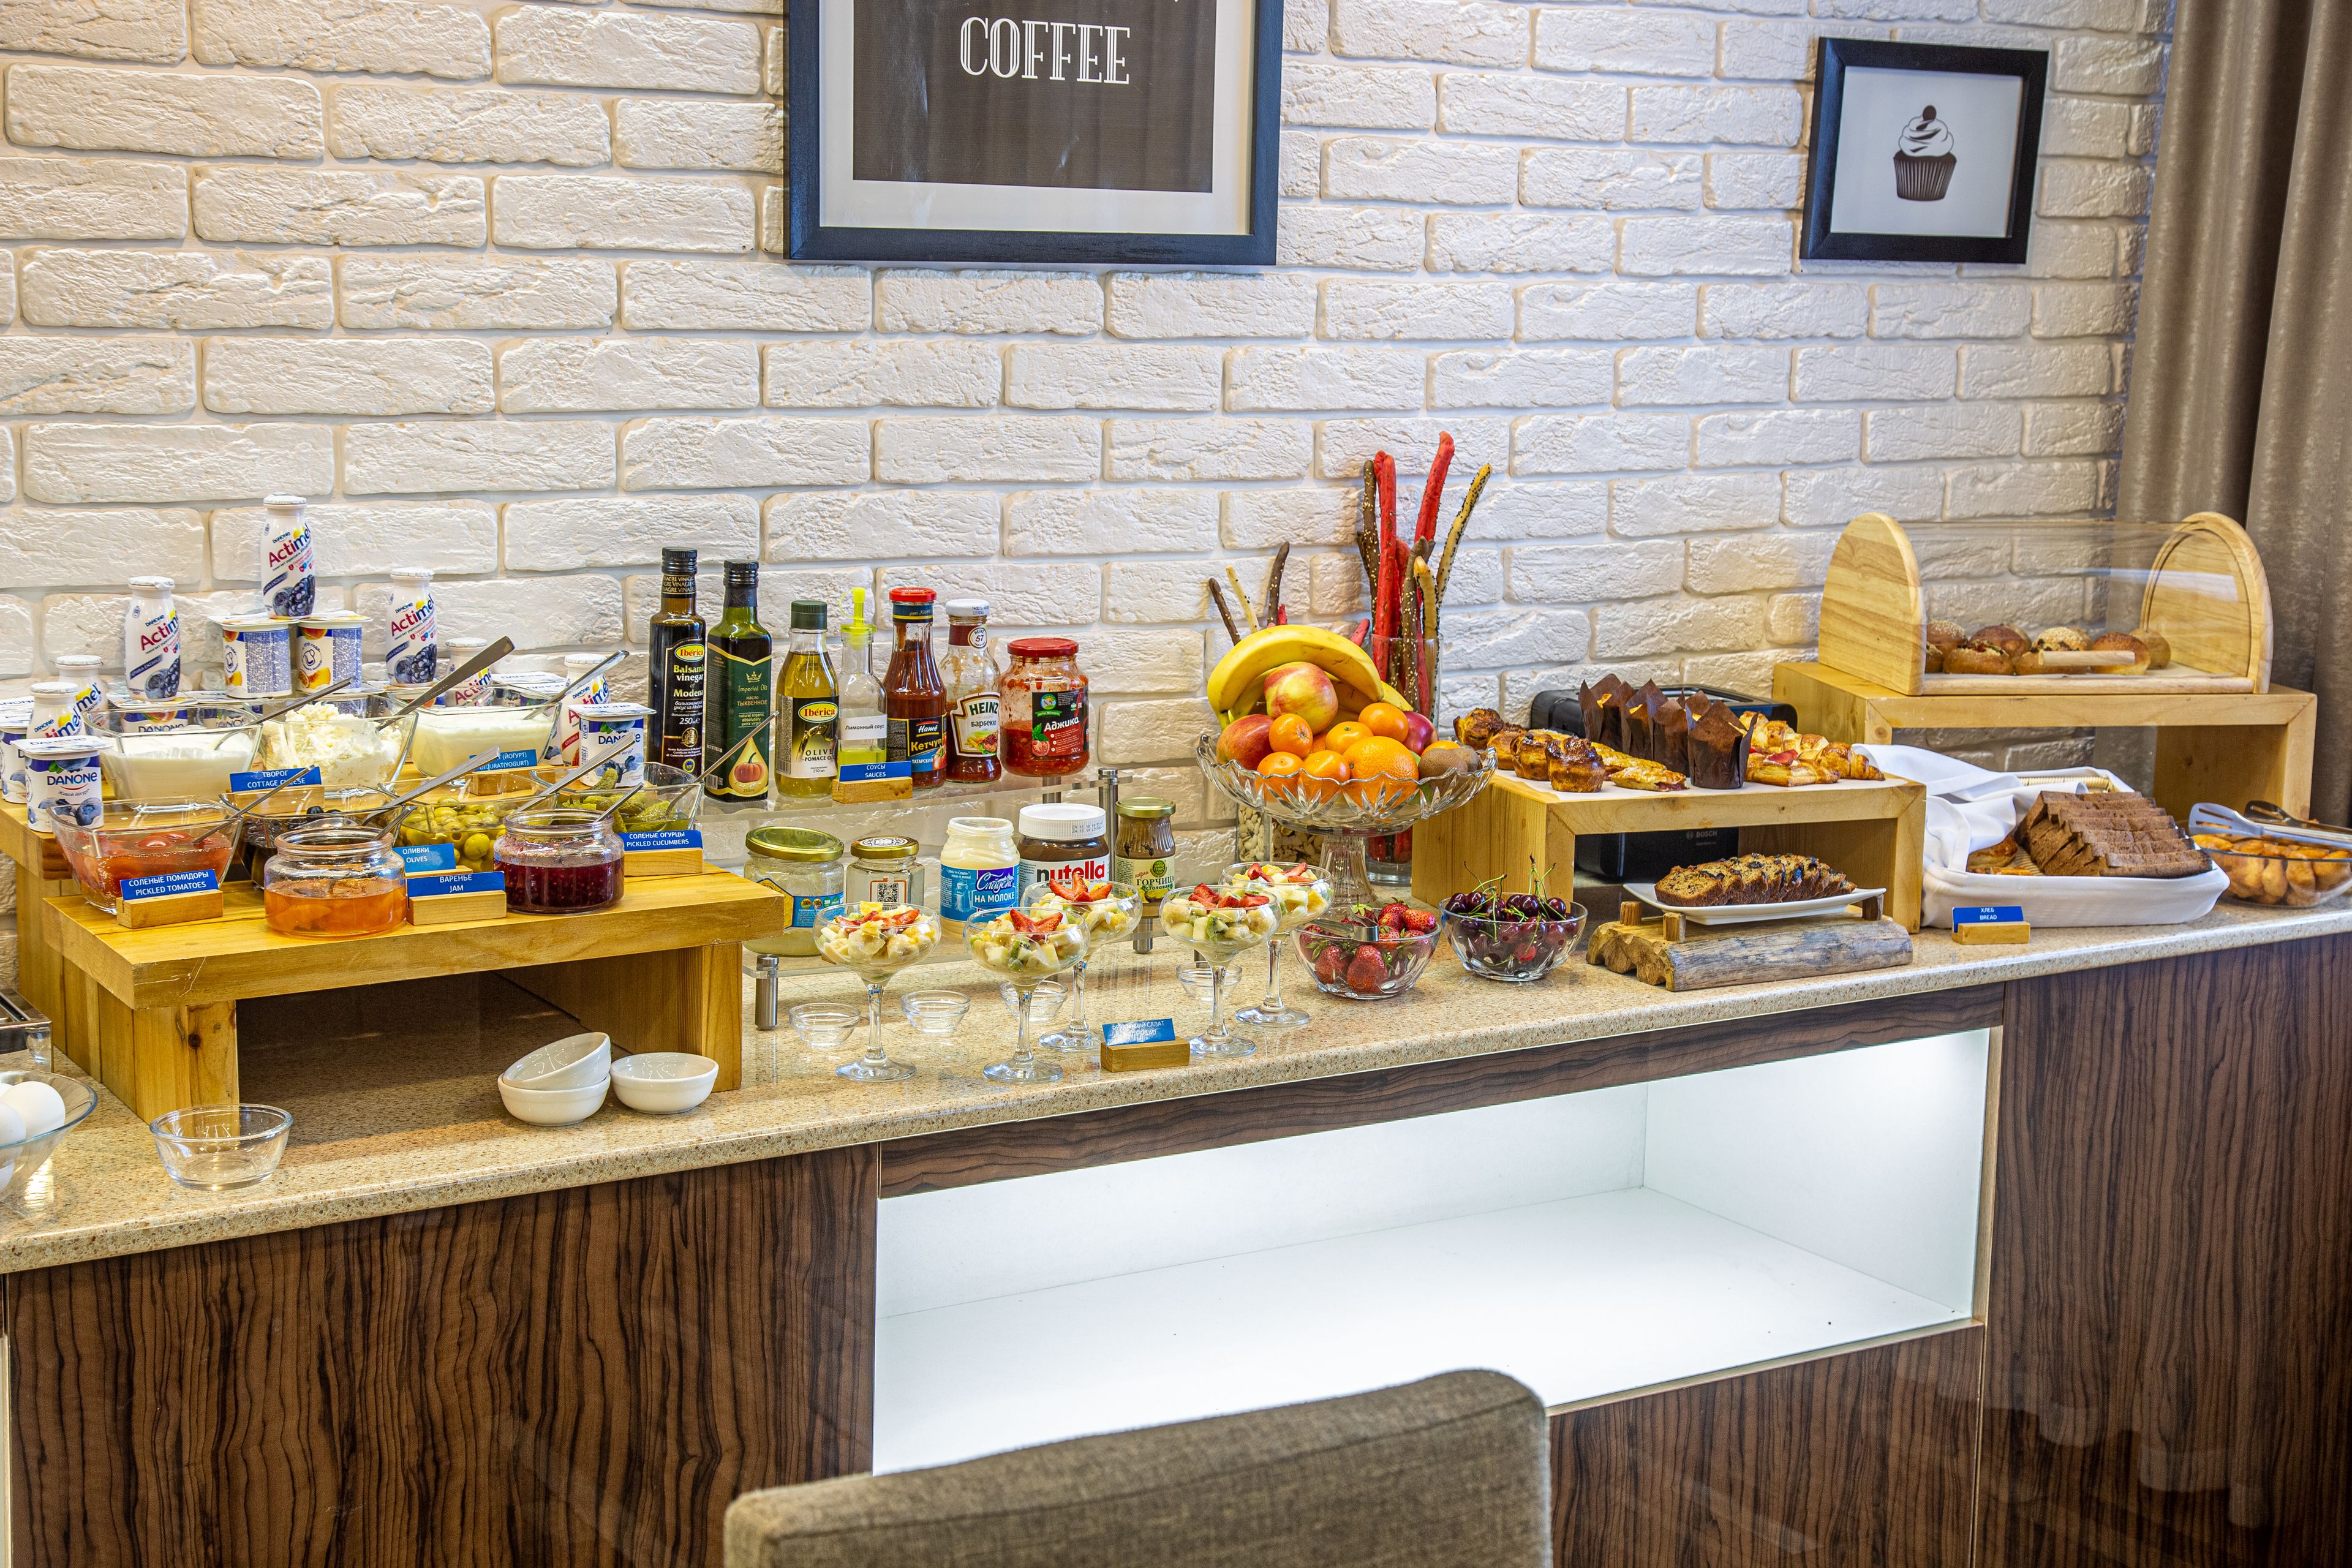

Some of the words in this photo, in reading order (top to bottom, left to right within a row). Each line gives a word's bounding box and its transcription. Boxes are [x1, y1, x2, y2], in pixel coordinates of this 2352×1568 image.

[960, 16, 1131, 85] COFFEE
[268, 522, 311, 568] Actimel
[391, 594, 434, 637] Actimel
[141, 615, 178, 651] Actim
[676, 673, 703, 683] vinegar
[674, 688, 703, 697] Modena
[804, 708, 835, 717] Ibérica
[969, 701, 999, 716] HEINZ
[1044, 717, 1080, 732] Аджика
[911, 739, 942, 752] Кетчуп
[47, 772, 97, 786] DANONE
[247, 780, 278, 788] COTTAGE
[440, 874, 472, 883] ВАРЕНЬЕ
[1037, 861, 1105, 883] nutella
[129, 876, 165, 887] СОЛЕНЫЕ
[167, 872, 209, 882] ПОМИДОРЫ
[1137, 876, 1175, 886] ГОРЧИЦА
[135, 886, 165, 896] PICKLED
[167, 881, 206, 892] TOMATOES
[449, 884, 464, 894] JAM
[988, 891, 1014, 903] МОЛОКЕ
